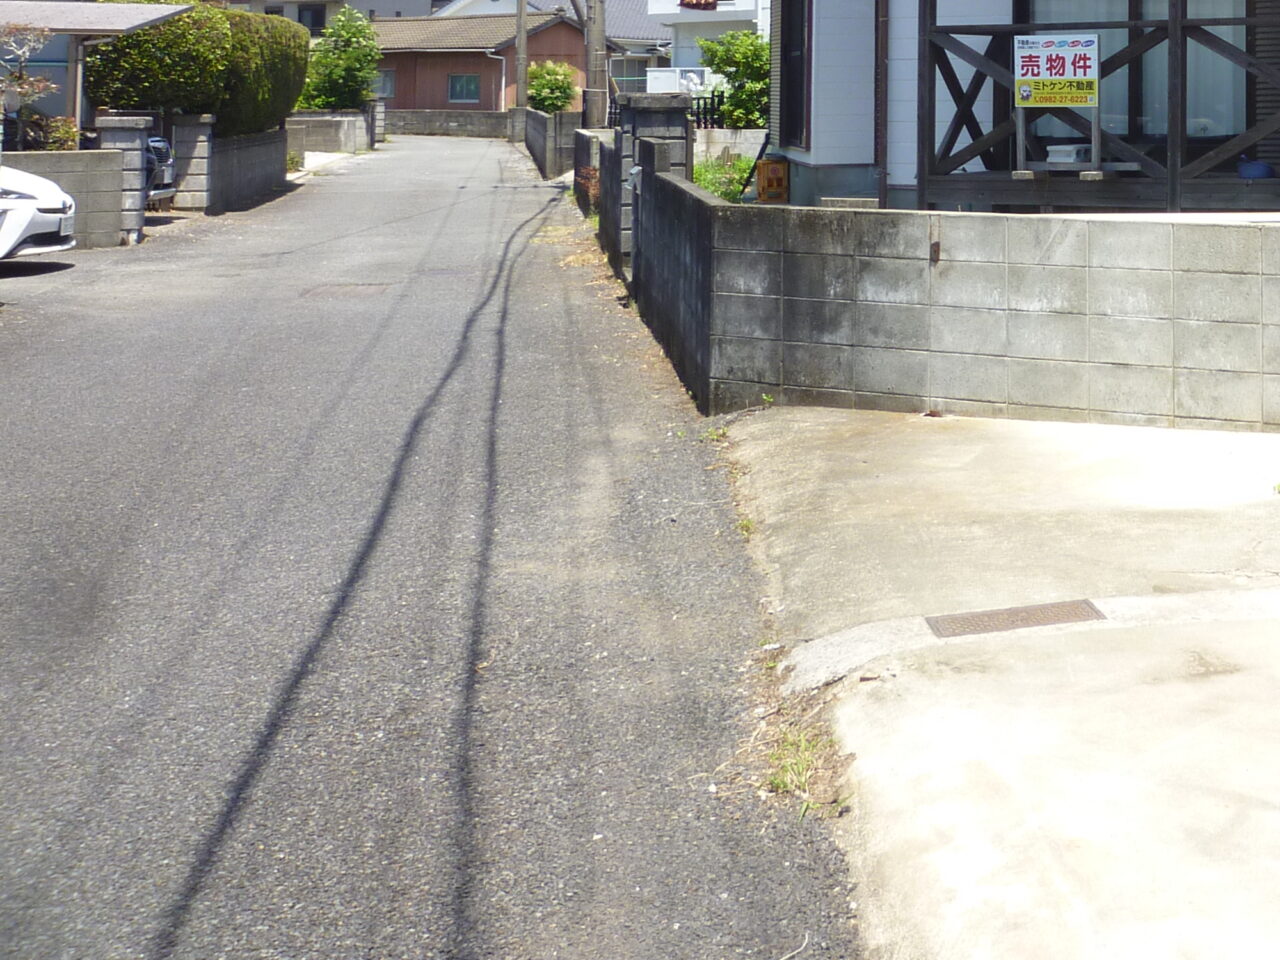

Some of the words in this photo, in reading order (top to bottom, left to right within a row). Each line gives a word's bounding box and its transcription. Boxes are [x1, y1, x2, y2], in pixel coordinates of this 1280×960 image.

[1020, 53, 1092, 77] 売物件
[1033, 81, 1095, 91] ミトケン不動産
